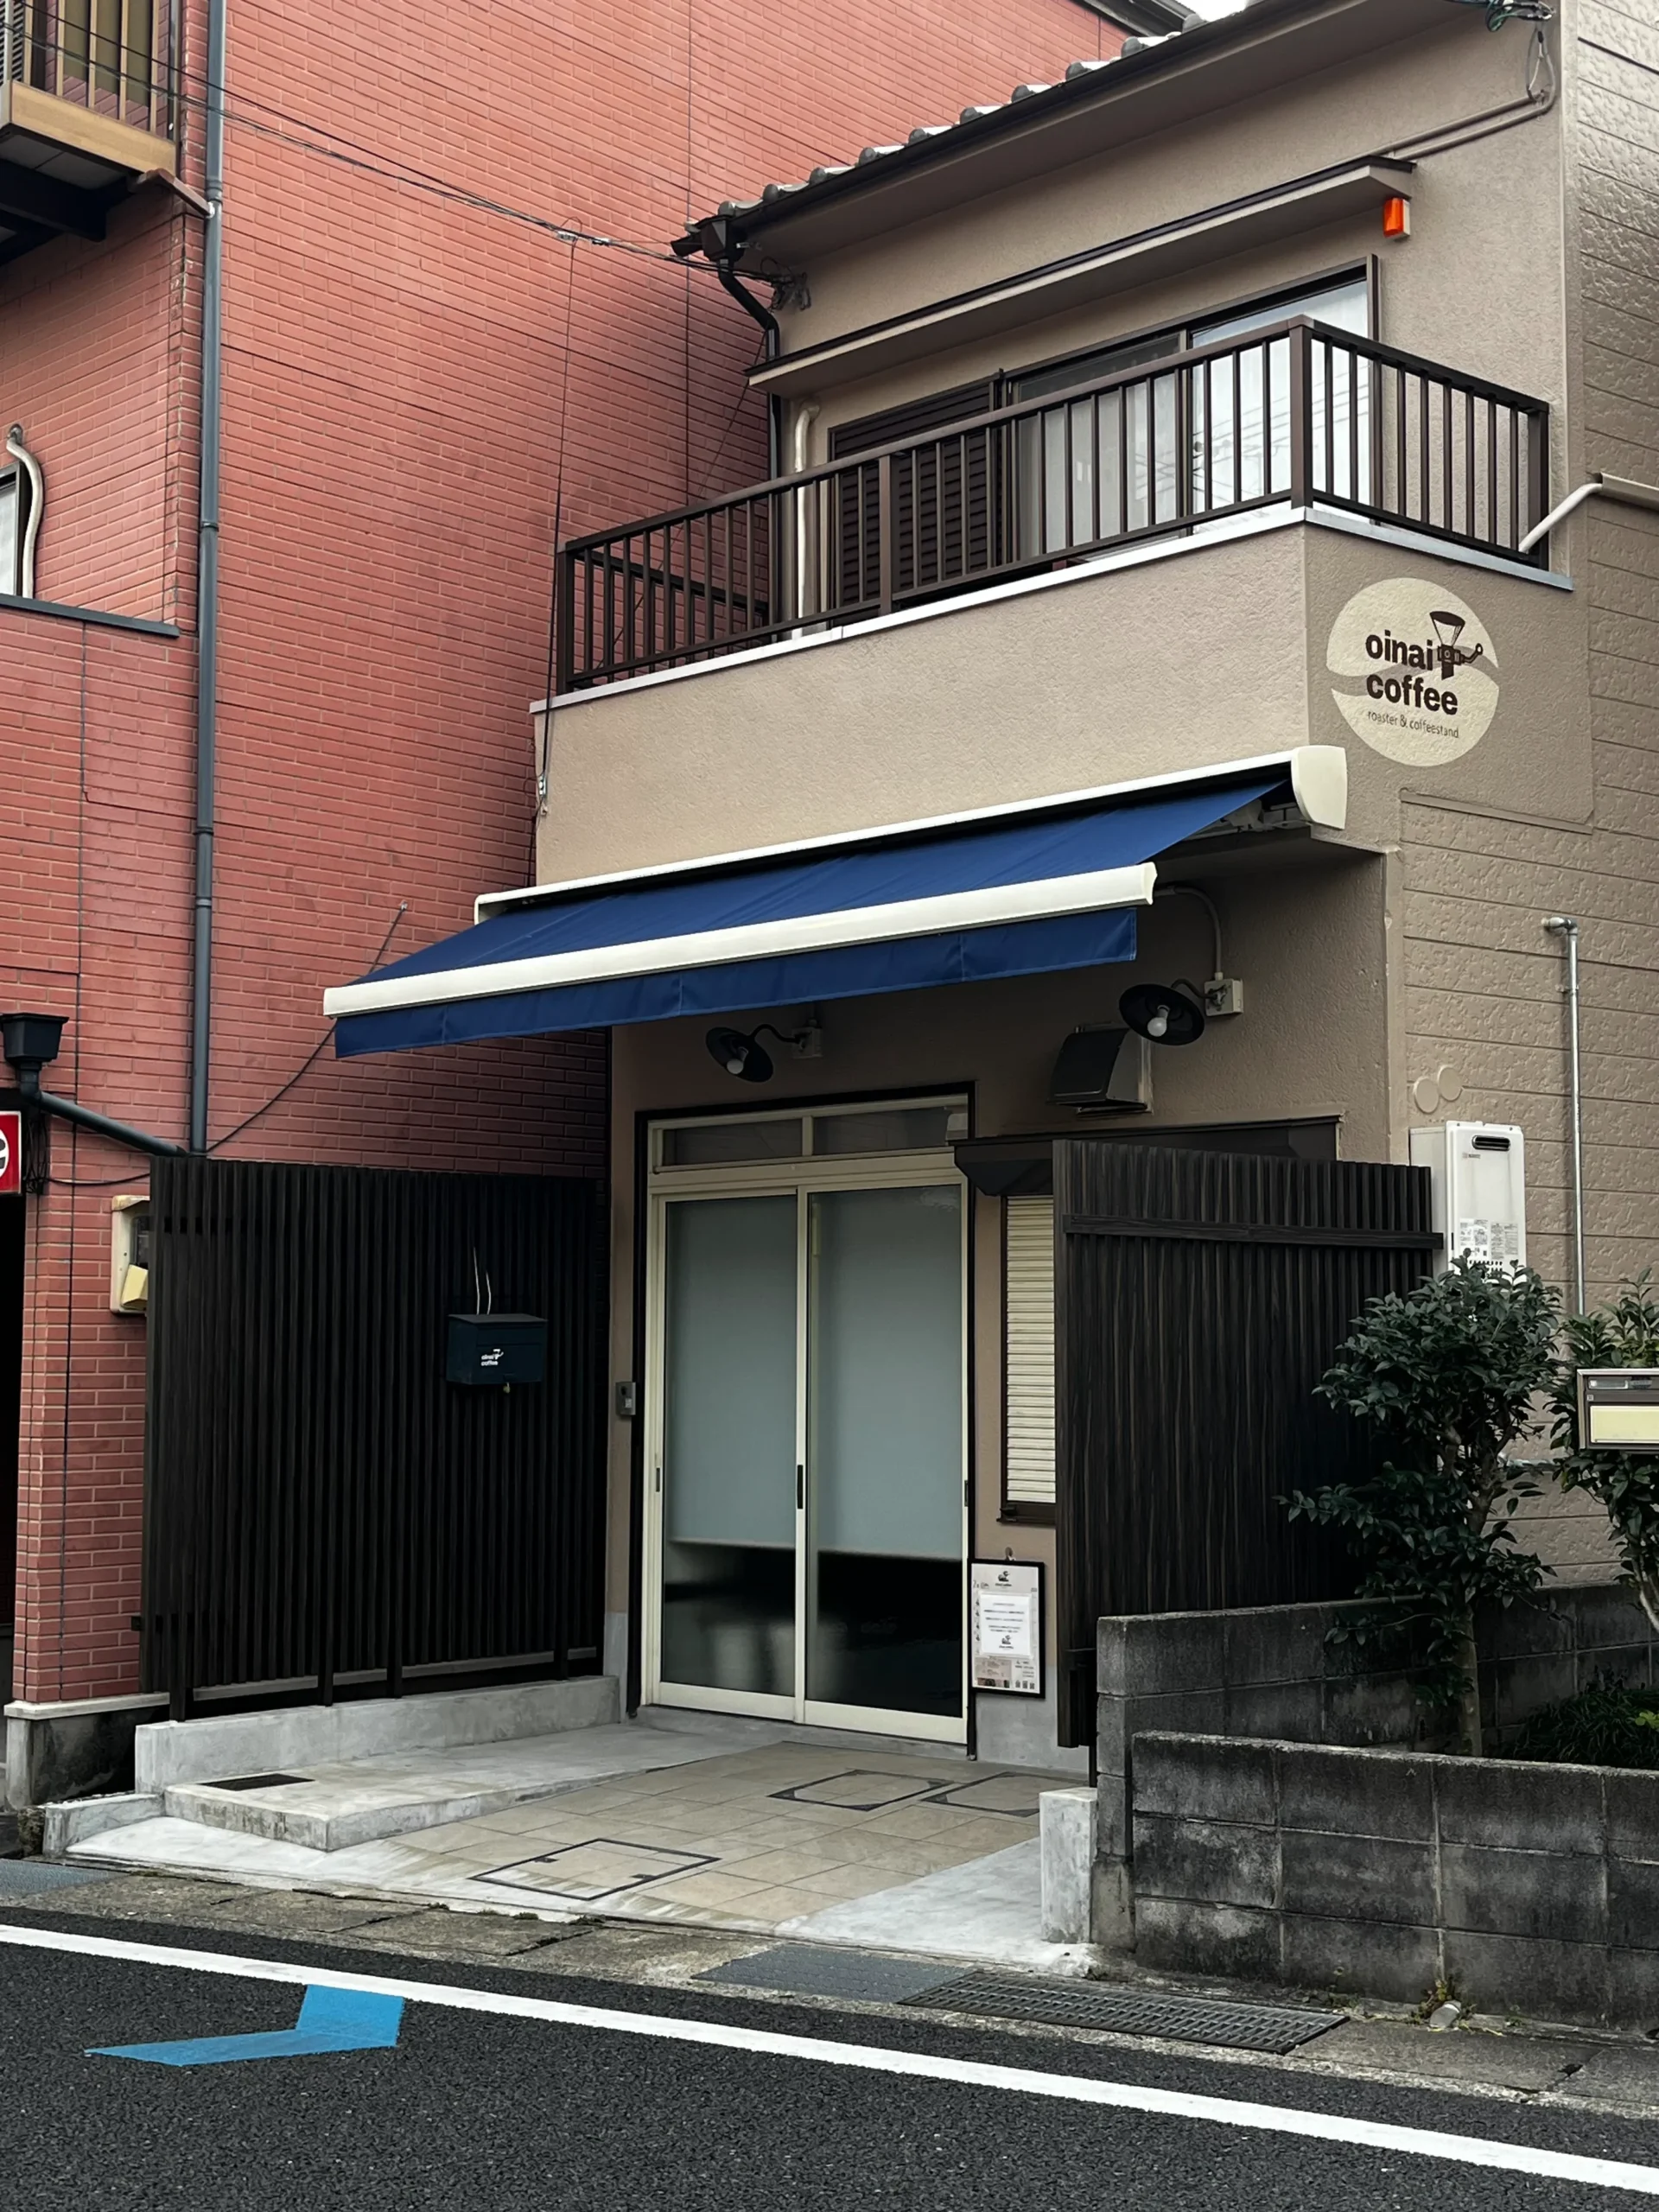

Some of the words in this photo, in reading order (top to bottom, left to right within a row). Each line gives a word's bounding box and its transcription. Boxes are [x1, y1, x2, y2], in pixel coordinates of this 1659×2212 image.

[1365, 629, 1433, 671] oinai
[1366, 674, 1458, 715] coffee
[1368, 710, 1398, 727] roaster
[1400, 714, 1408, 728] &
[1409, 719, 1459, 738] coffeestand
